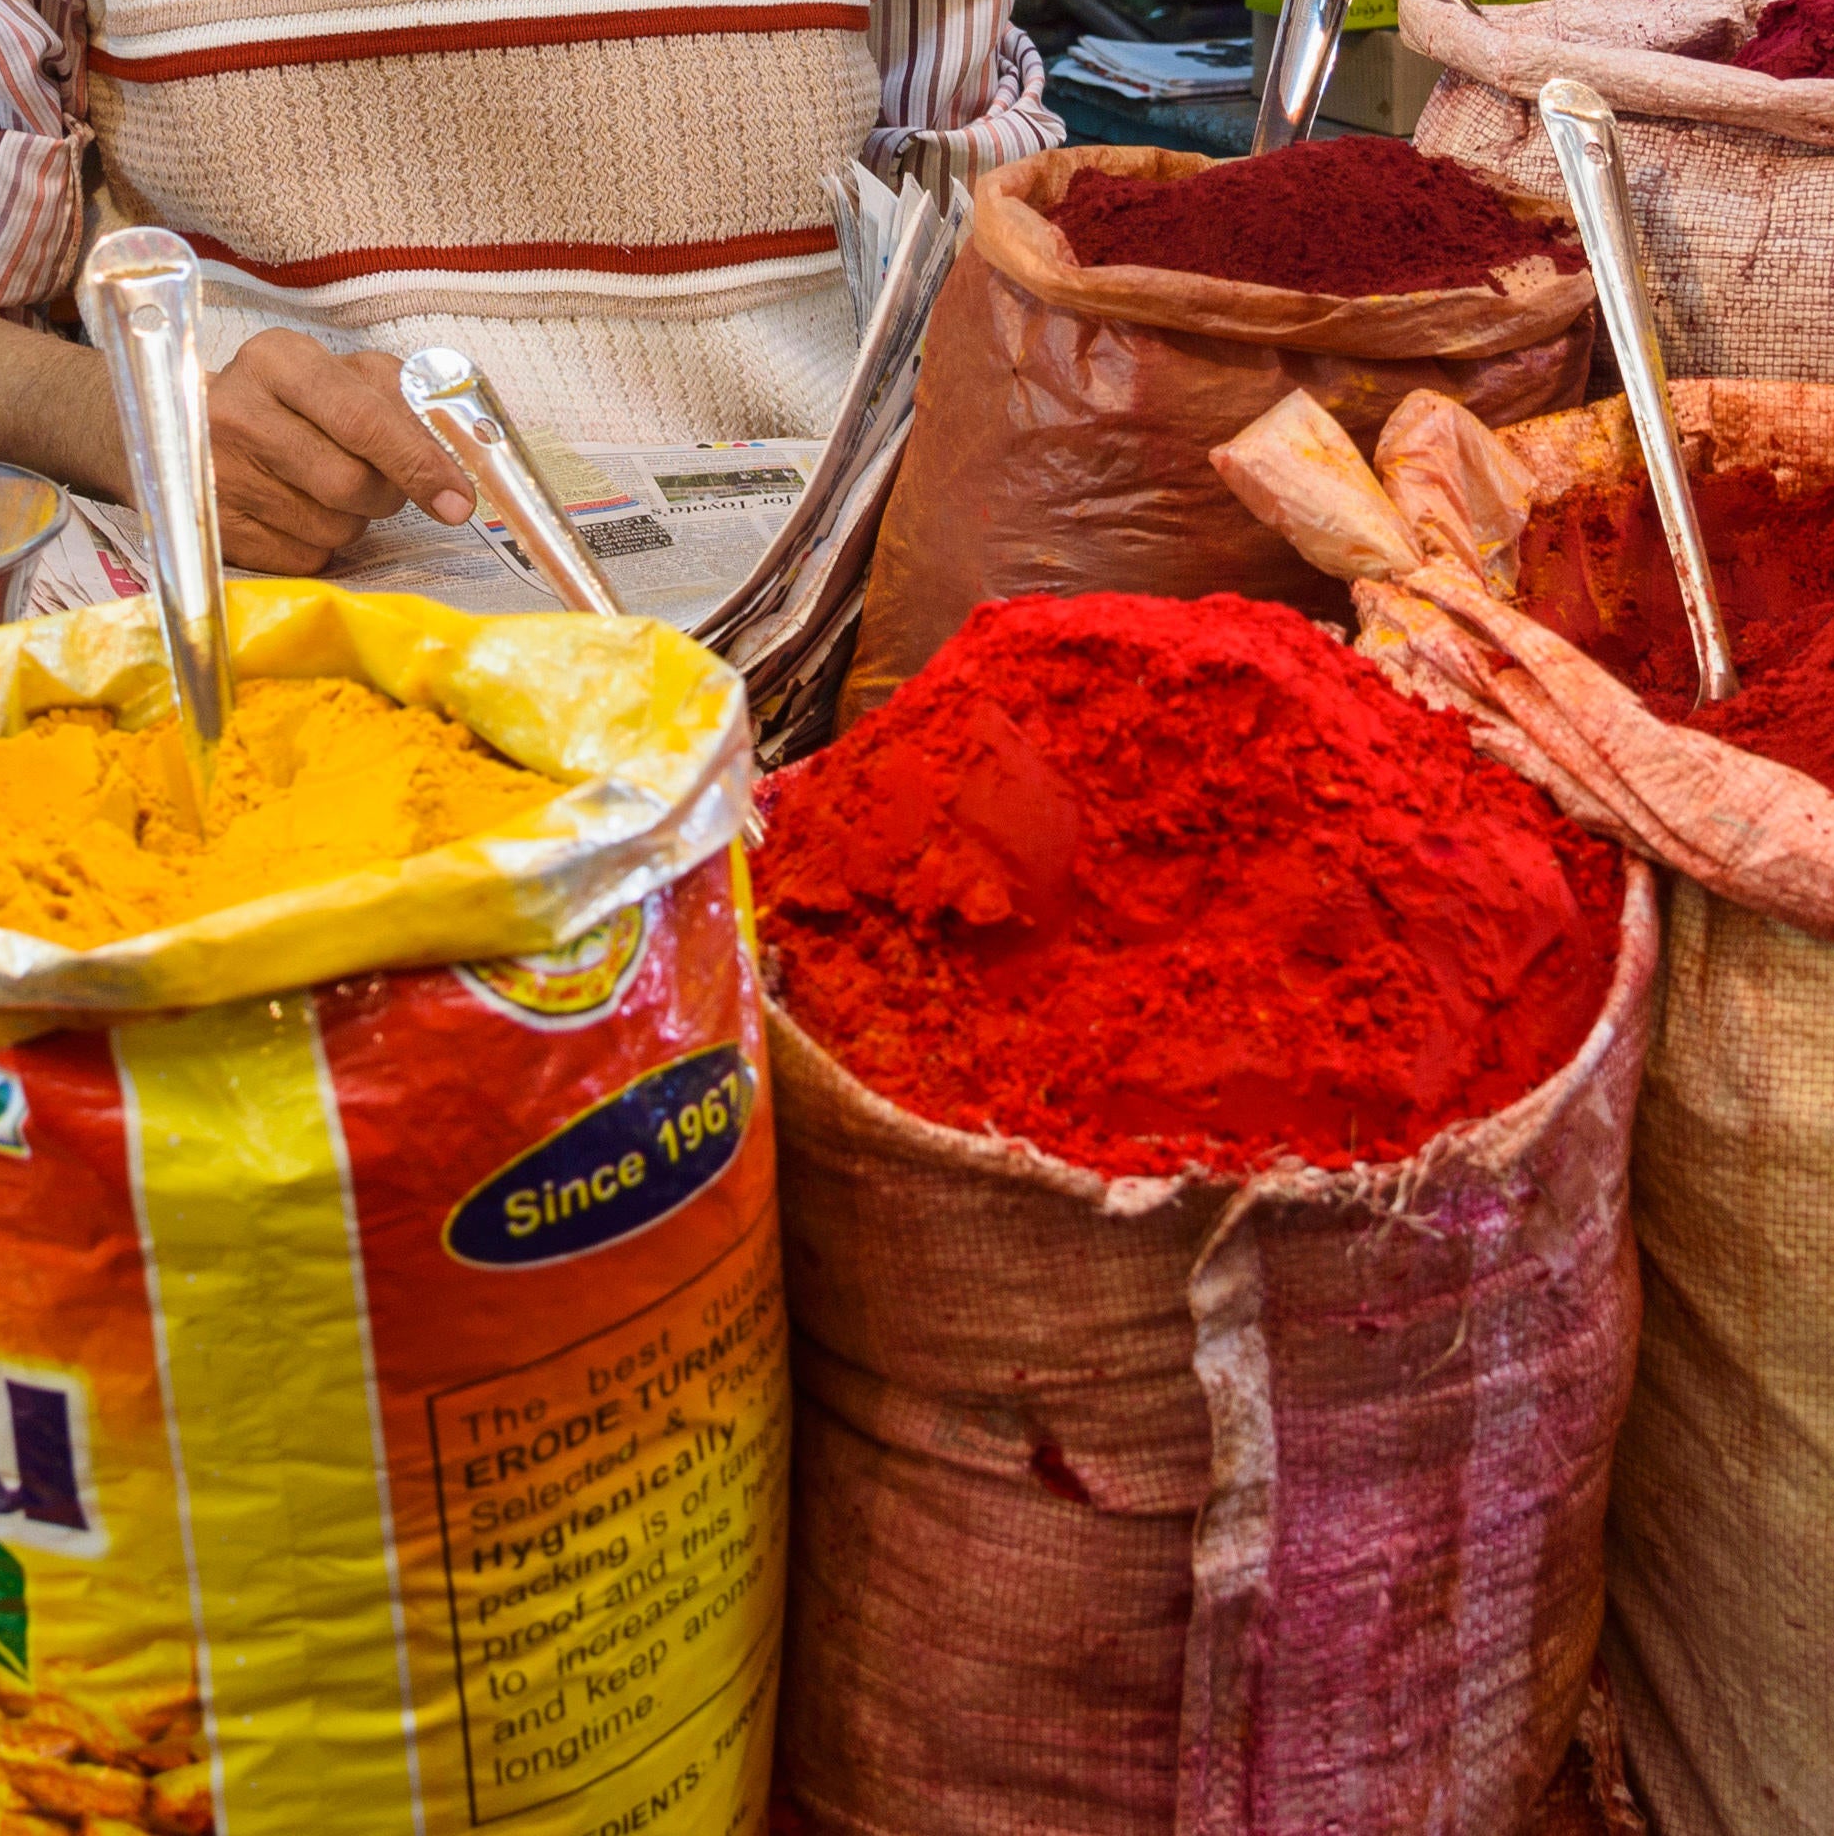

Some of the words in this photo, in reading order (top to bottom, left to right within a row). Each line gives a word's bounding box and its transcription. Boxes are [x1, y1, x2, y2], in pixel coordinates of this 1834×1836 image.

[650, 498, 753, 518] Toyota's
[758, 494, 791, 508] for
[502, 1150, 646, 1238] Since
[656, 1070, 739, 1163] 1967
[461, 1396, 549, 1445] The
[587, 1329, 672, 1396] best
[466, 1400, 623, 1489] ERODE
[469, 1430, 640, 1535] Selected
[663, 1407, 687, 1438] &
[471, 1416, 737, 1574] Hygienically
[477, 1534, 630, 1625] packing
[640, 1510, 669, 1545] is
[680, 1474, 711, 1518] of
[482, 1590, 585, 1662] proof
[603, 1548, 667, 1610] and
[680, 1507, 731, 1560] this
[488, 1668, 527, 1703] to
[556, 1574, 701, 1677] increase
[719, 1523, 757, 1573] the
[492, 1689, 567, 1744] and
[586, 1636, 668, 1706] keep
[495, 1693, 662, 1786] longtime.
